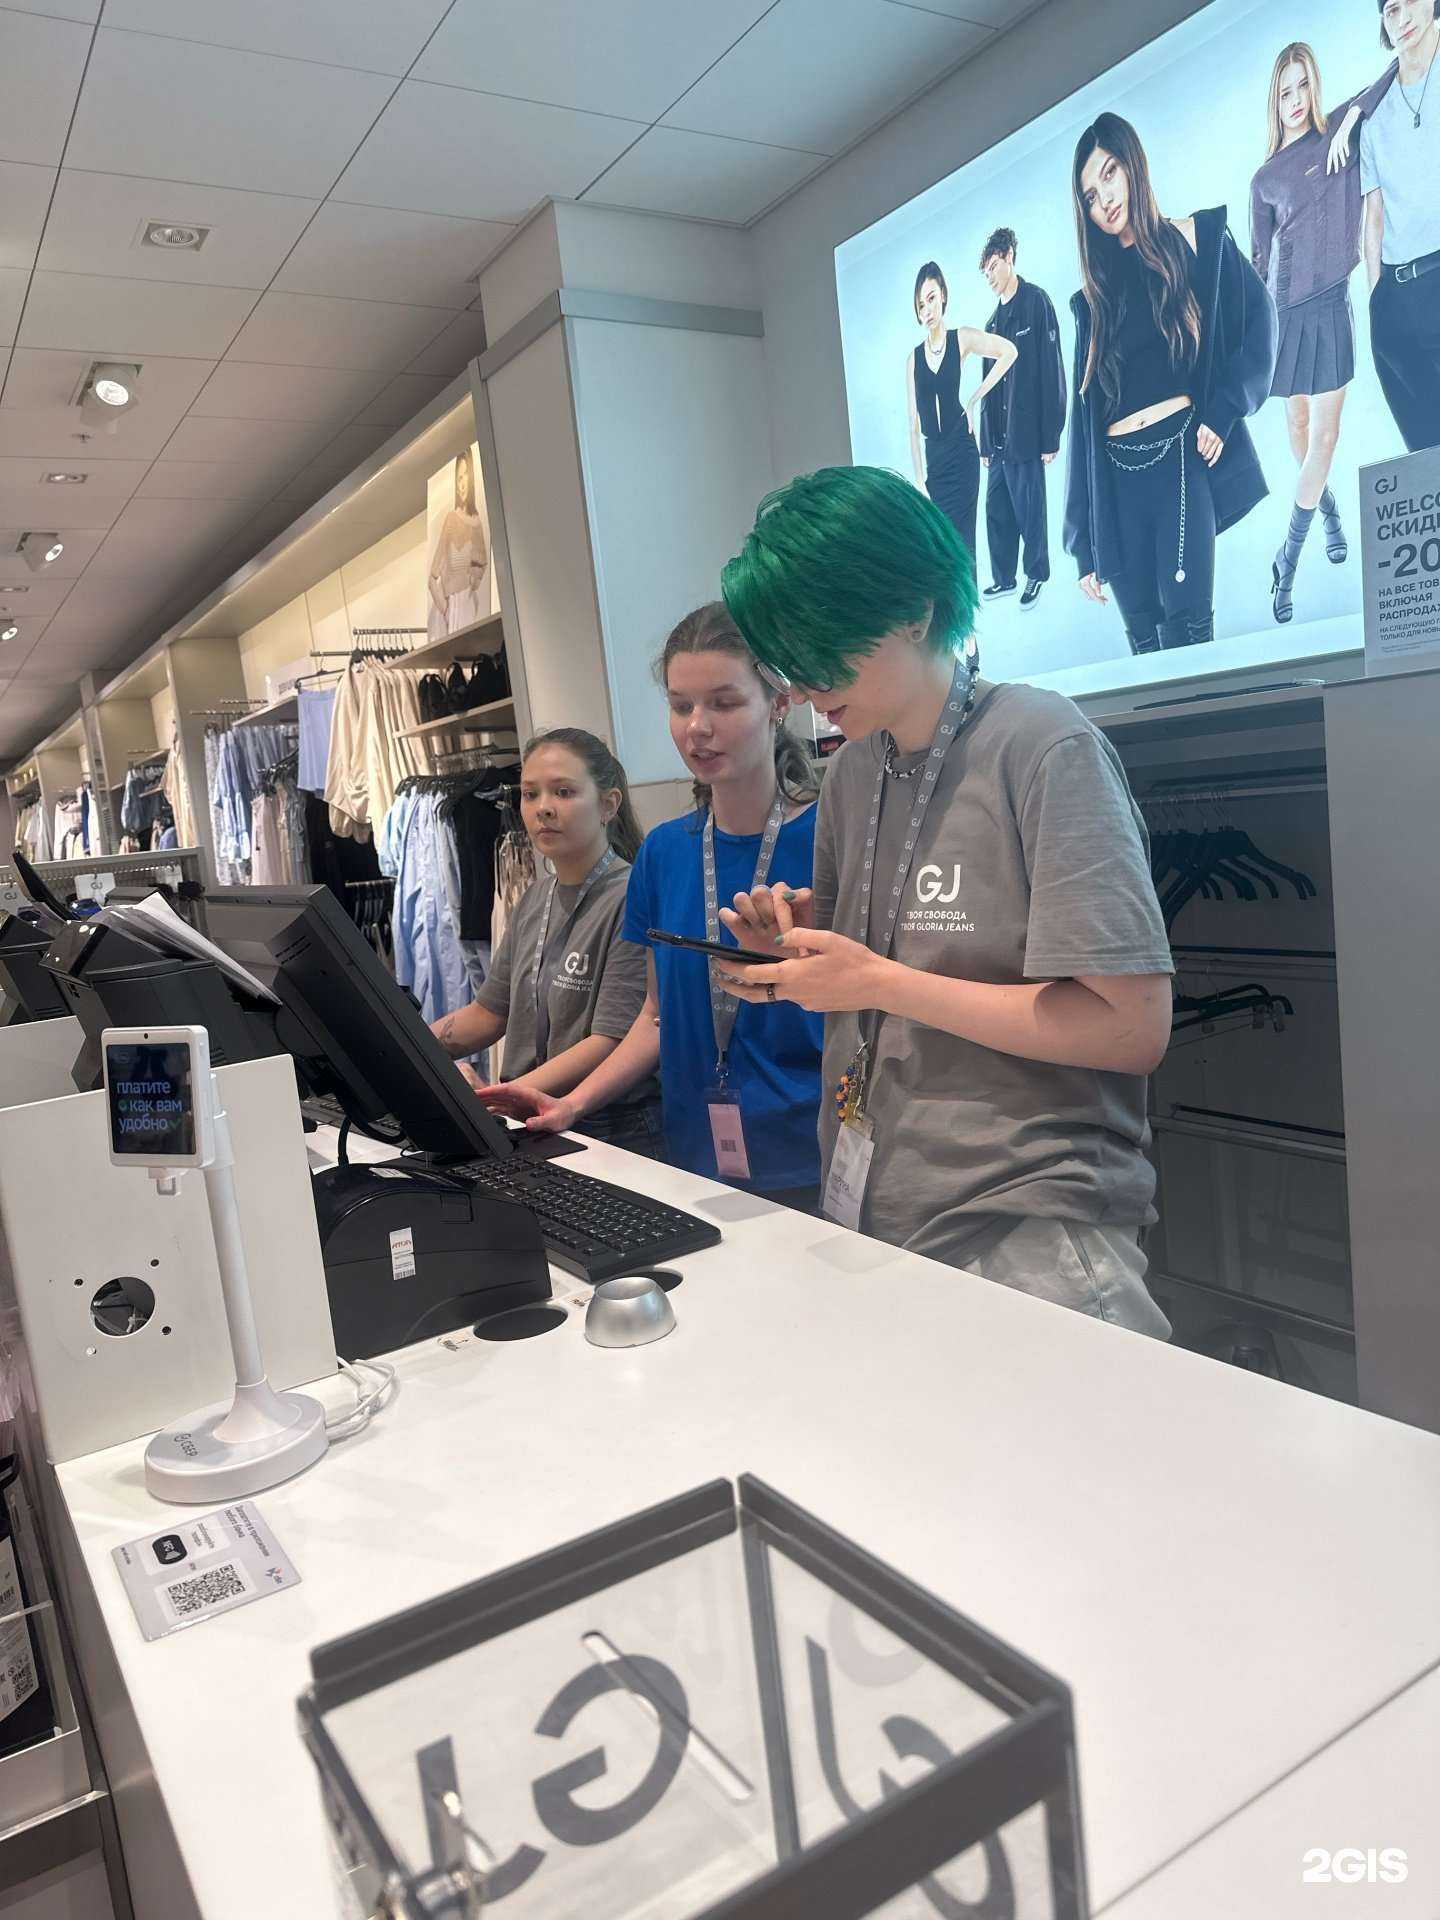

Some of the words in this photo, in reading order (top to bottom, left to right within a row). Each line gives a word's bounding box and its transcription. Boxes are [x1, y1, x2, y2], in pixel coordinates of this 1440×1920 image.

[1375, 475, 1397, 494] GJ
[1377, 512, 1440, 541] СКИД
[1378, 587, 1392, 598] НА
[1395, 583, 1416, 594] ВСЕ
[1379, 592, 1433, 609] ВКЛЮЧАЯ
[940, 725, 954, 735] GJ
[932, 748, 945, 758] GJ
[925, 772, 936, 781] GJ
[916, 864, 961, 903] GJ
[924, 910, 967, 921] СВОБОДА
[916, 922, 944, 931] GLORIA
[945, 922, 975, 932] JEANS
[564, 951, 590, 975] GJ
[116, 1081, 171, 1094] платите
[129, 1100, 153, 1112] как
[156, 1101, 183, 1112] вам
[118, 1113, 169, 1134] удобно
